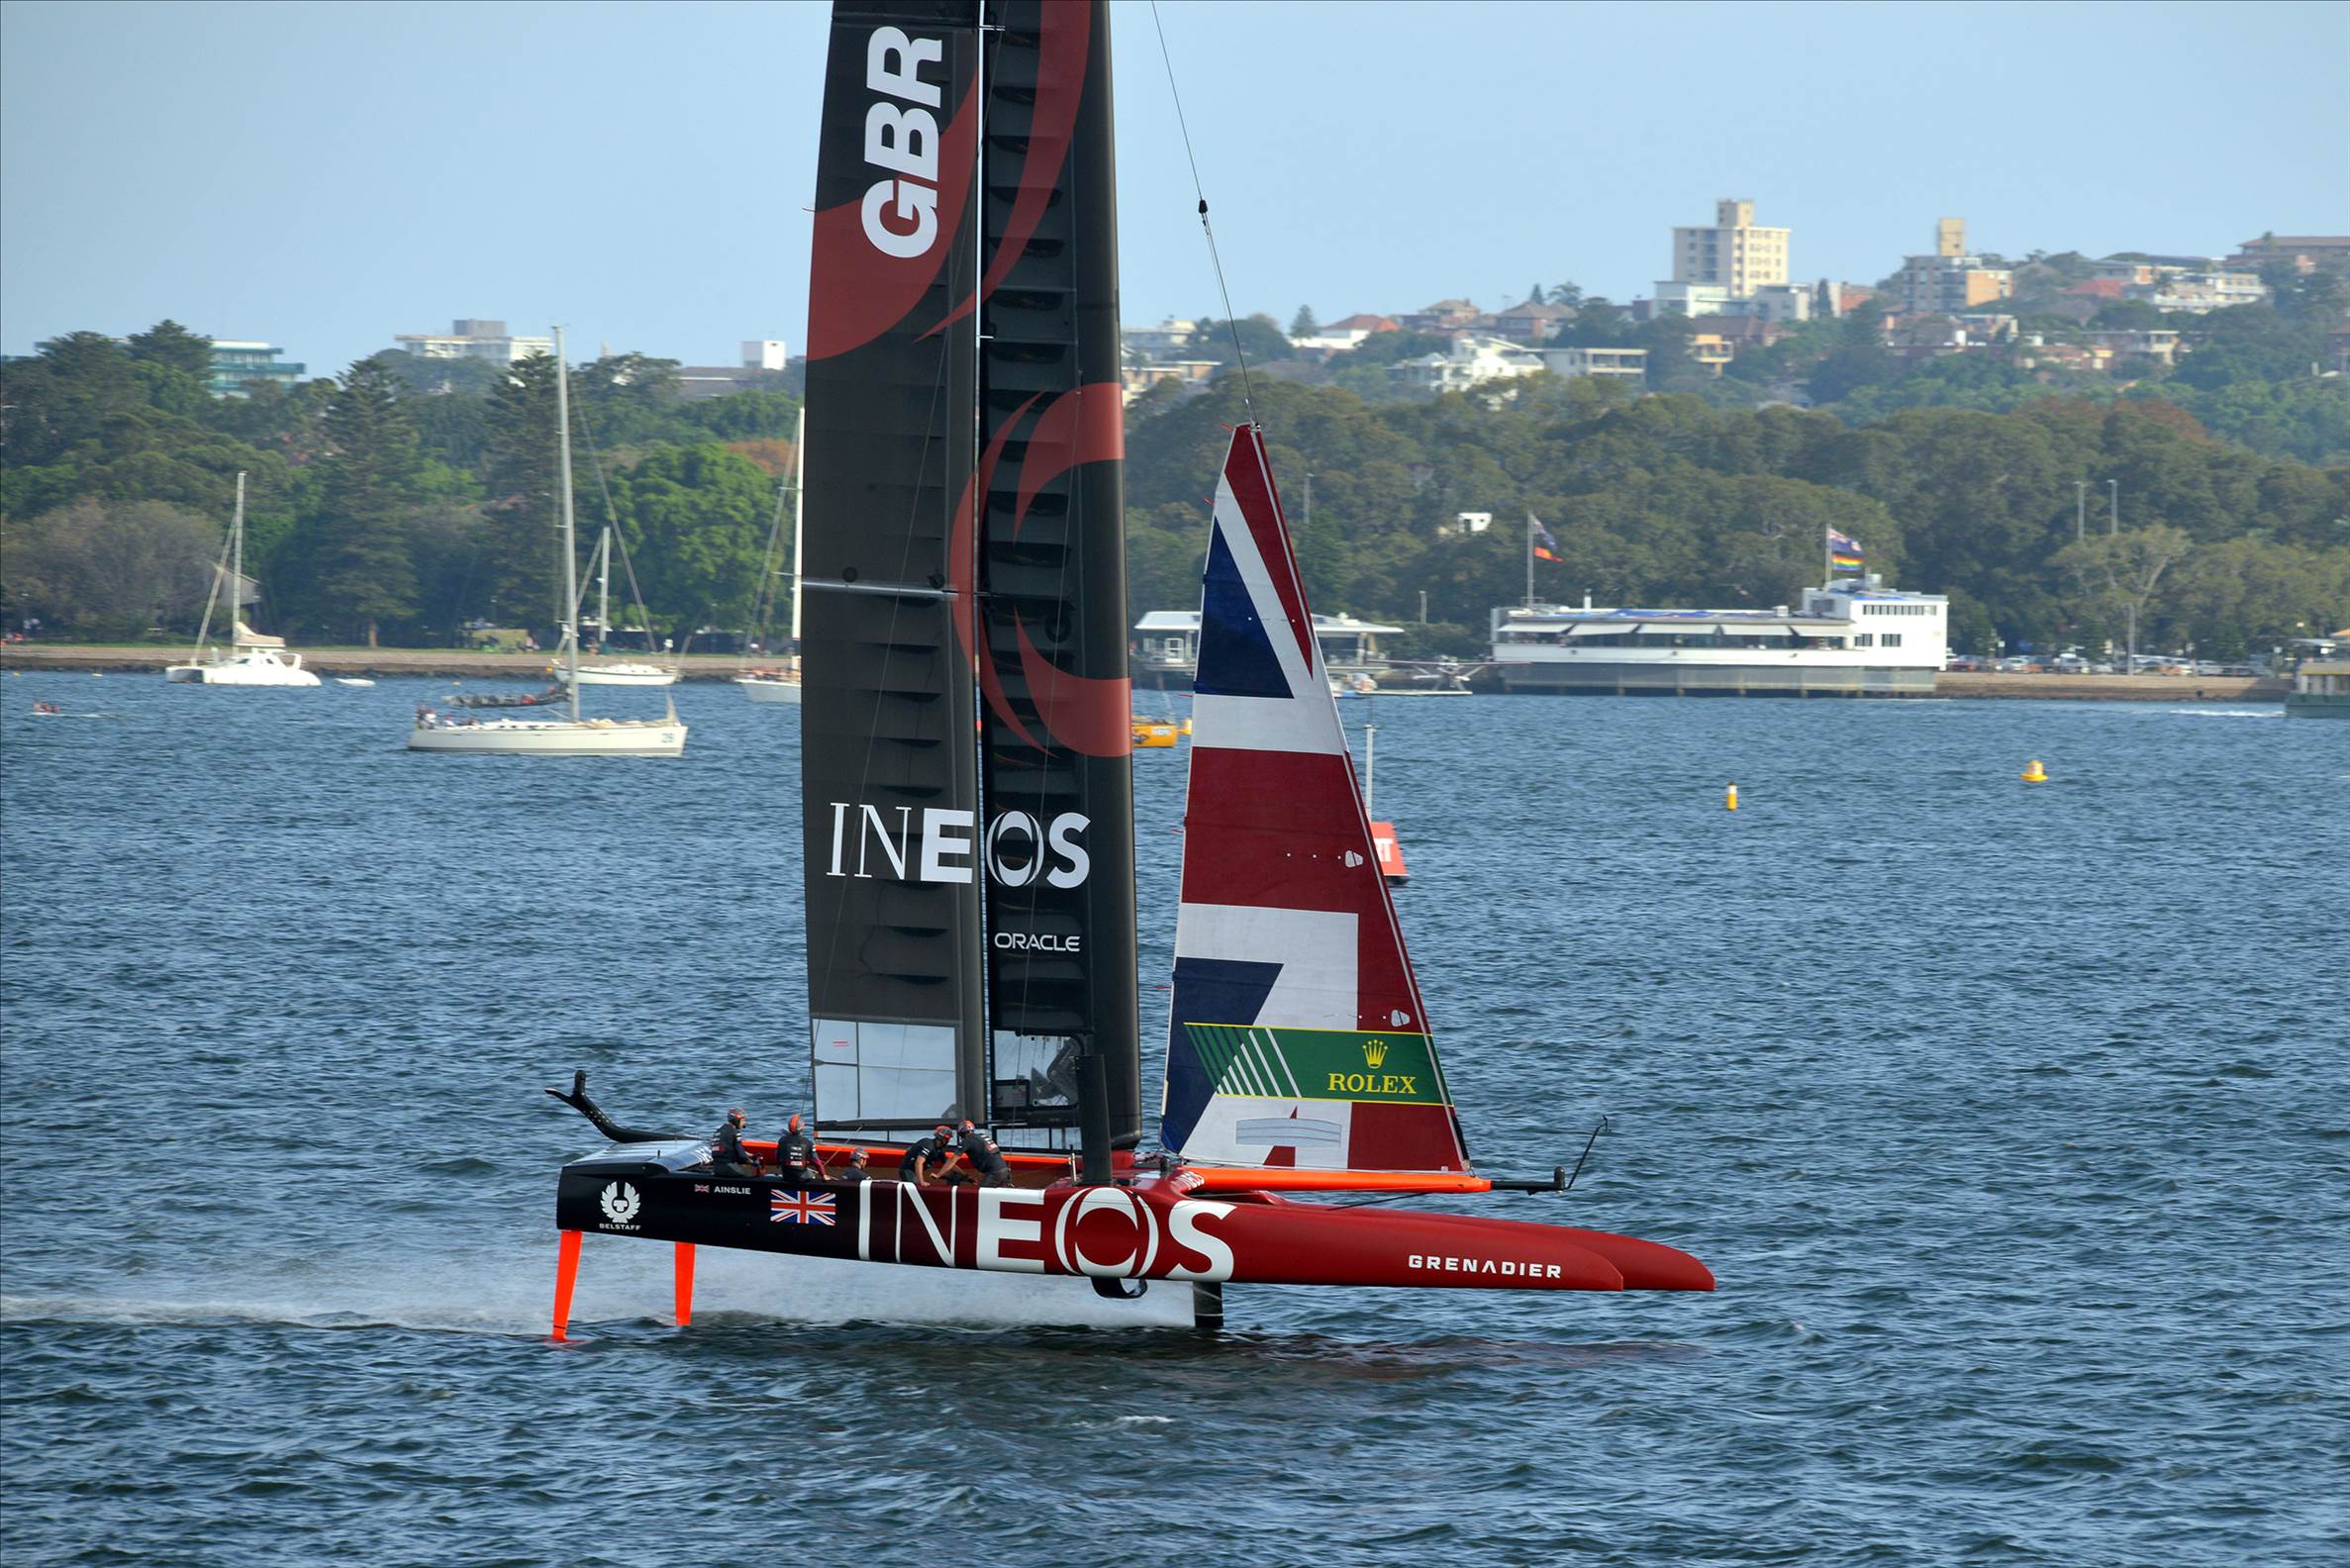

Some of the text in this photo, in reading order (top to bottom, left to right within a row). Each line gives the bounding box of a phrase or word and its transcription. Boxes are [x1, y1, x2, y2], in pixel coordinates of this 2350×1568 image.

[860, 26, 943, 259] GBR
[826, 802, 1092, 889] INEOS
[994, 931, 1081, 952] ORACLE
[1327, 1073, 1418, 1094] ROLEX
[858, 1179, 1236, 1283] INEOS
[1409, 1254, 1562, 1279] GRENADIER
